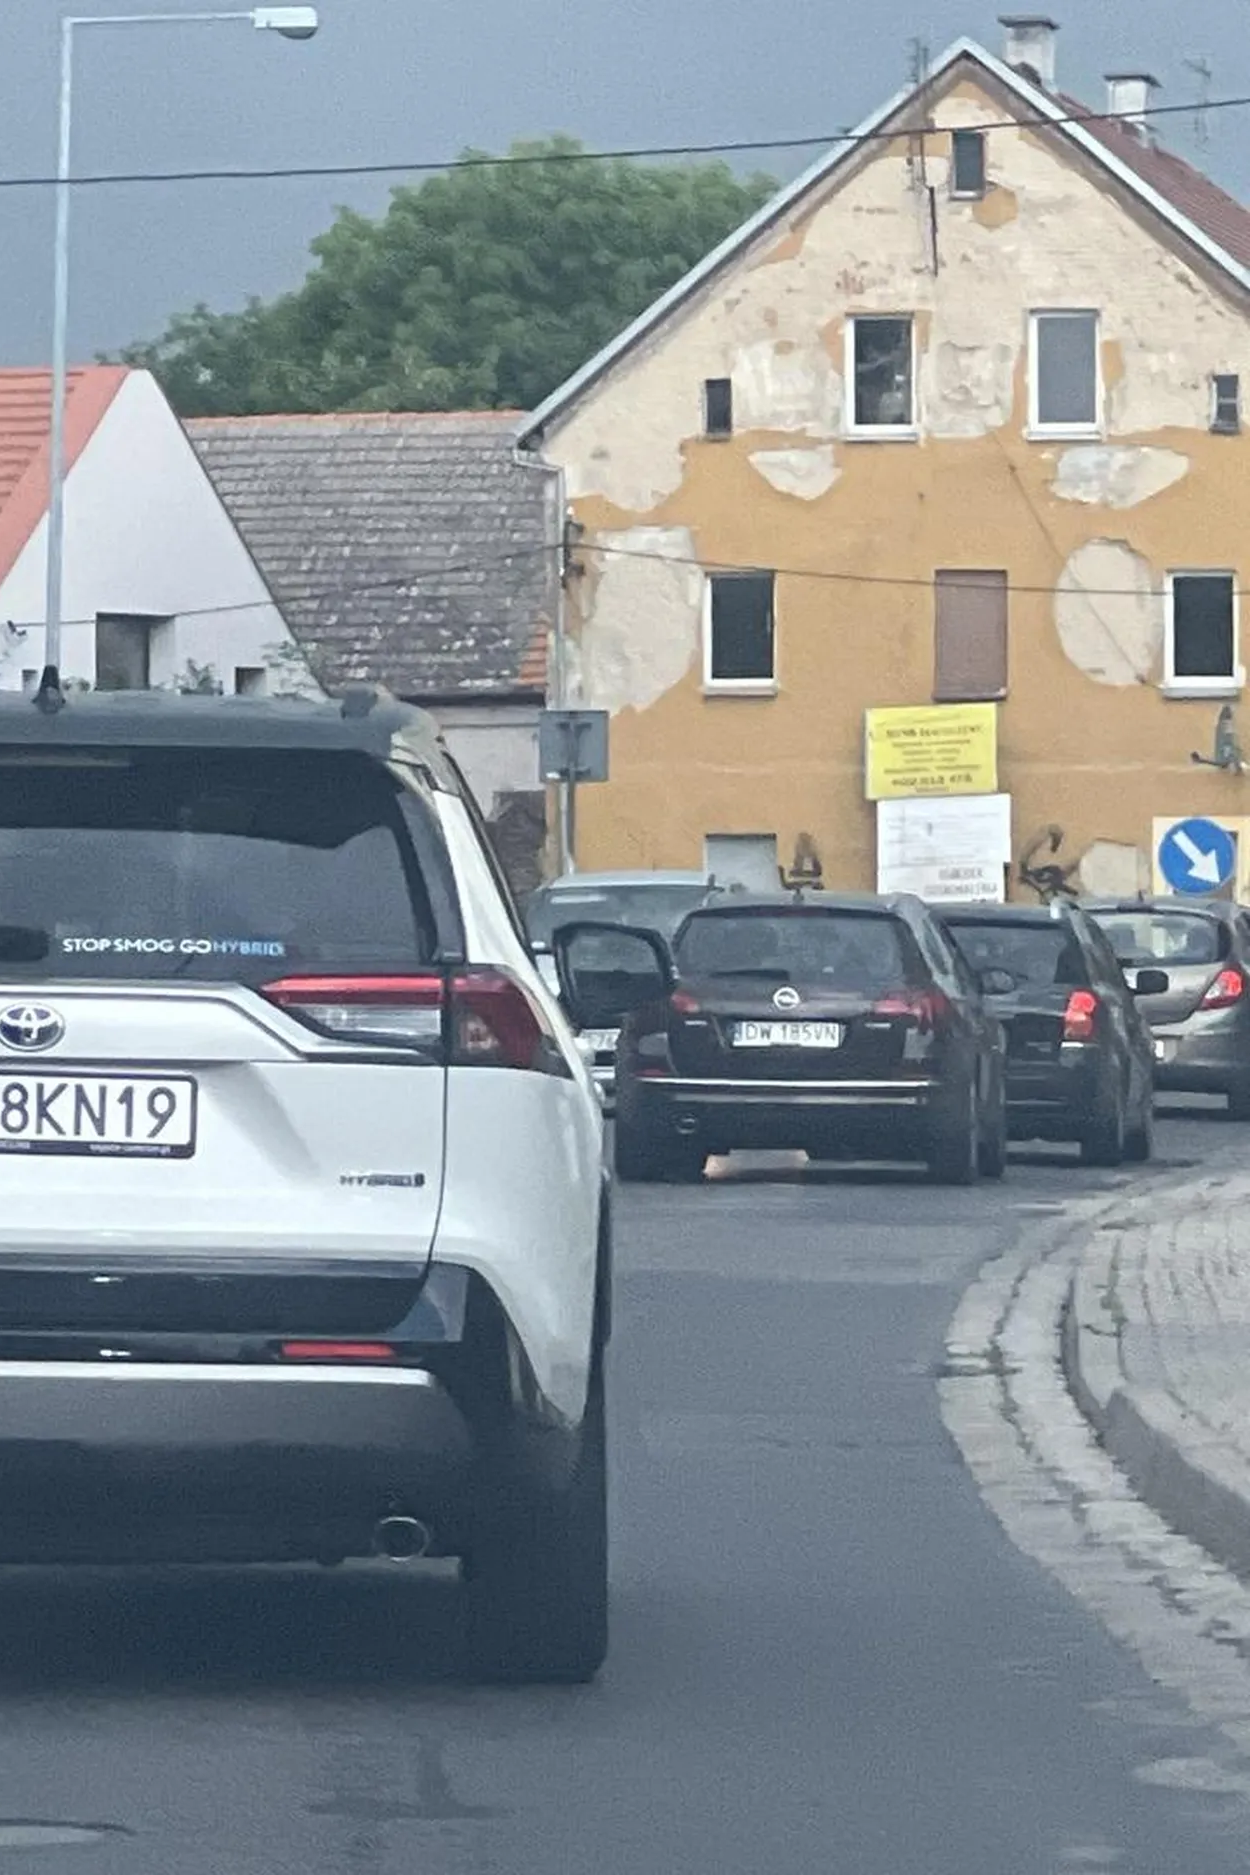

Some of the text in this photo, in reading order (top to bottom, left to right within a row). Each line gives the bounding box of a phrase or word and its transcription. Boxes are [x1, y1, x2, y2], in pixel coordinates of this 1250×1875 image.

[62, 938, 111, 952] STOP
[114, 938, 175, 953] SMOG
[744, 1023, 772, 1040] DW
[1, 1082, 177, 1138] 8KN19
